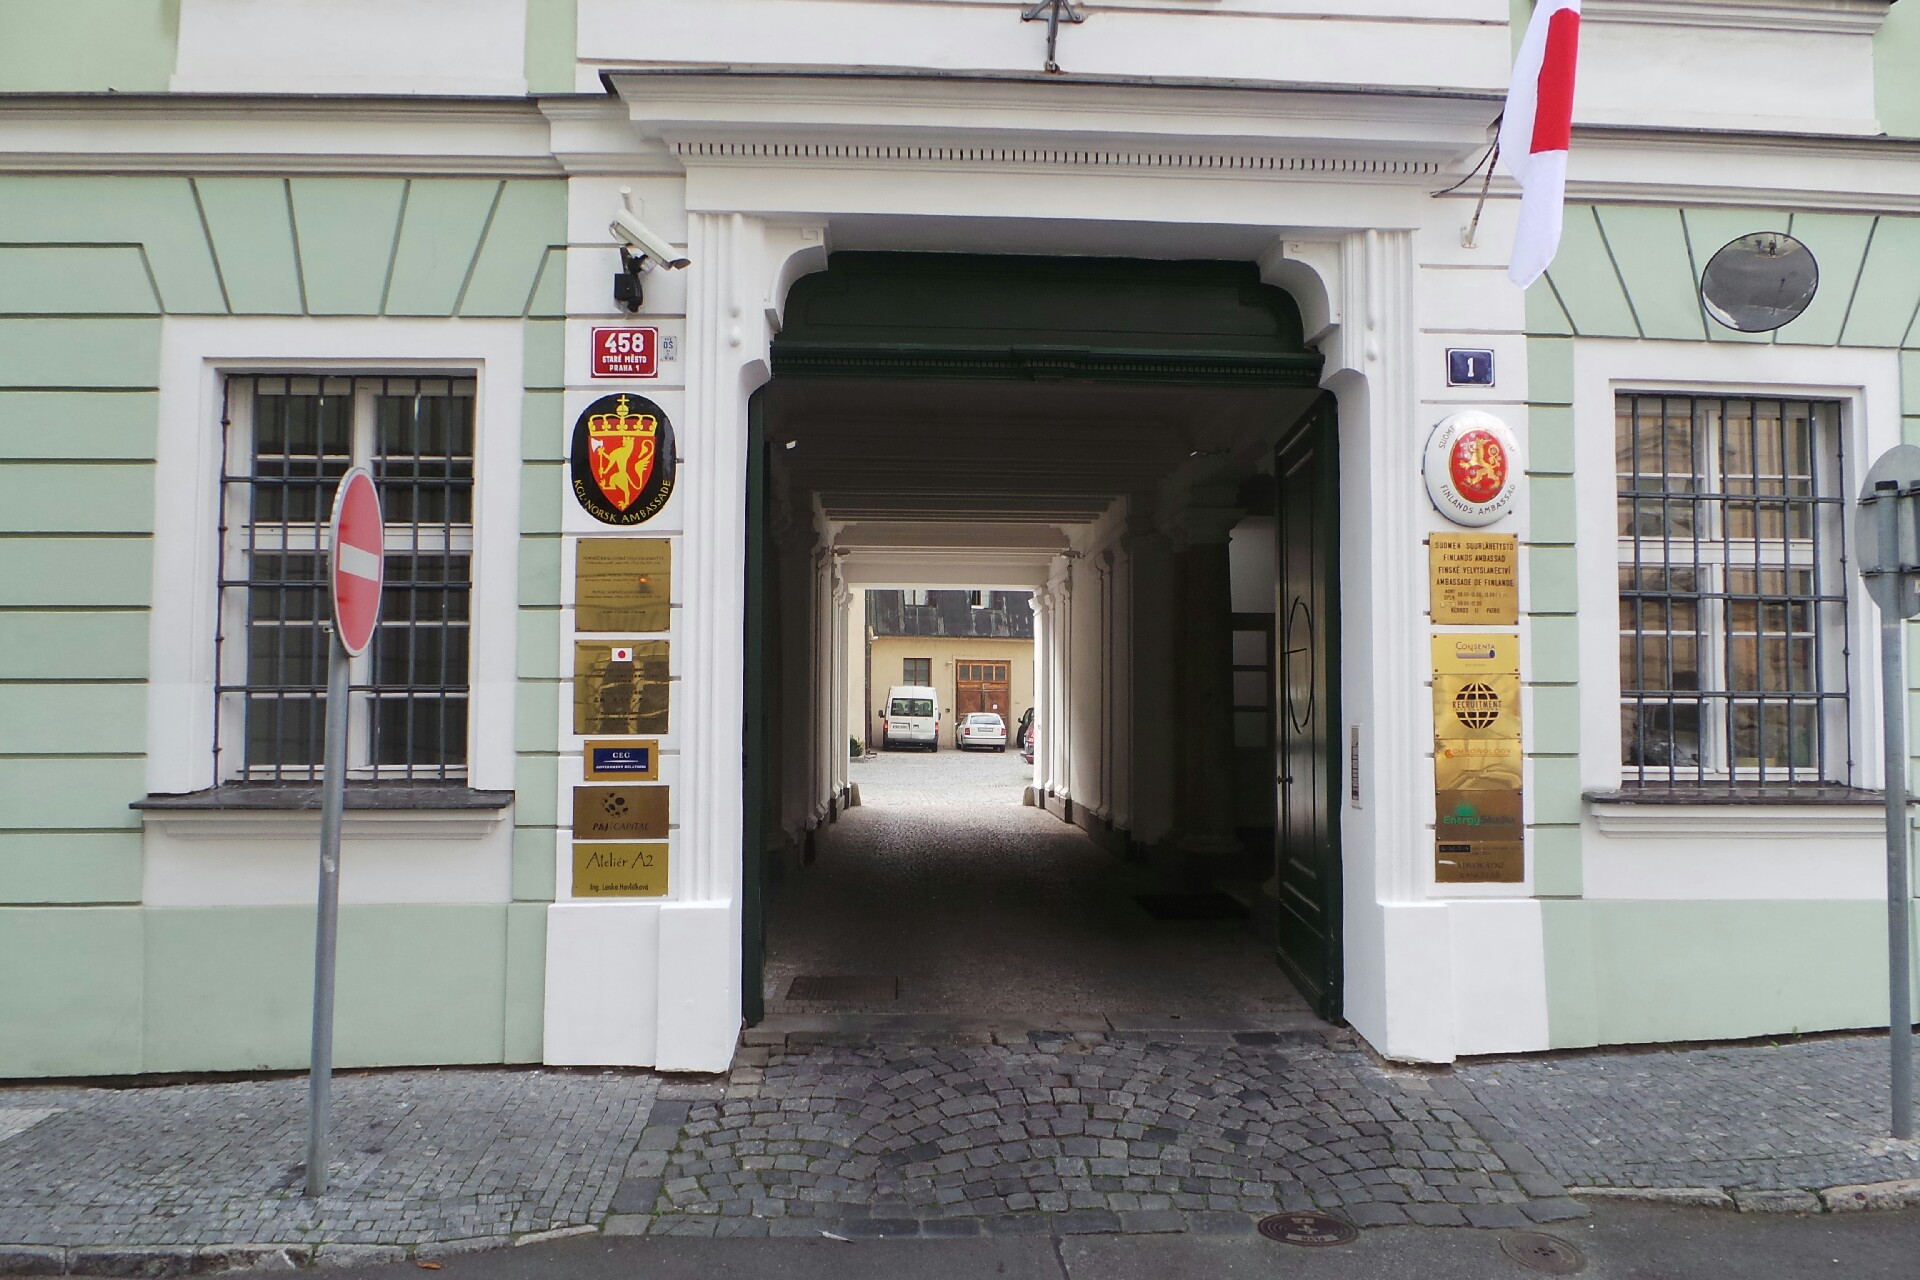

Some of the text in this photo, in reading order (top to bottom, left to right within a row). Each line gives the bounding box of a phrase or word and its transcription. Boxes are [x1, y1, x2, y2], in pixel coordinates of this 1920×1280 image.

[604, 332, 644, 353] 458
[602, 354, 647, 364] STARÉ MĚSTO
[1467, 357, 1474, 378] 1
[584, 499, 617, 522] NORSK
[621, 480, 671, 523] AMBASSADE
[1440, 484, 1516, 515] FINLANDS AMBASSAD
[1435, 542, 1461, 550] SUOMEN
[1444, 554, 1506, 562] FINLANDS AMBASSAD
[1438, 564, 1511, 574] FINSKÉ VELVYSLANECTVÍ
[1484, 578, 1514, 586] FINLANDE
[1452, 700, 1502, 708] RECRUITMENT
[614, 822, 648, 830] CAPITAL
[586, 851, 654, 869] Ateliér A2
